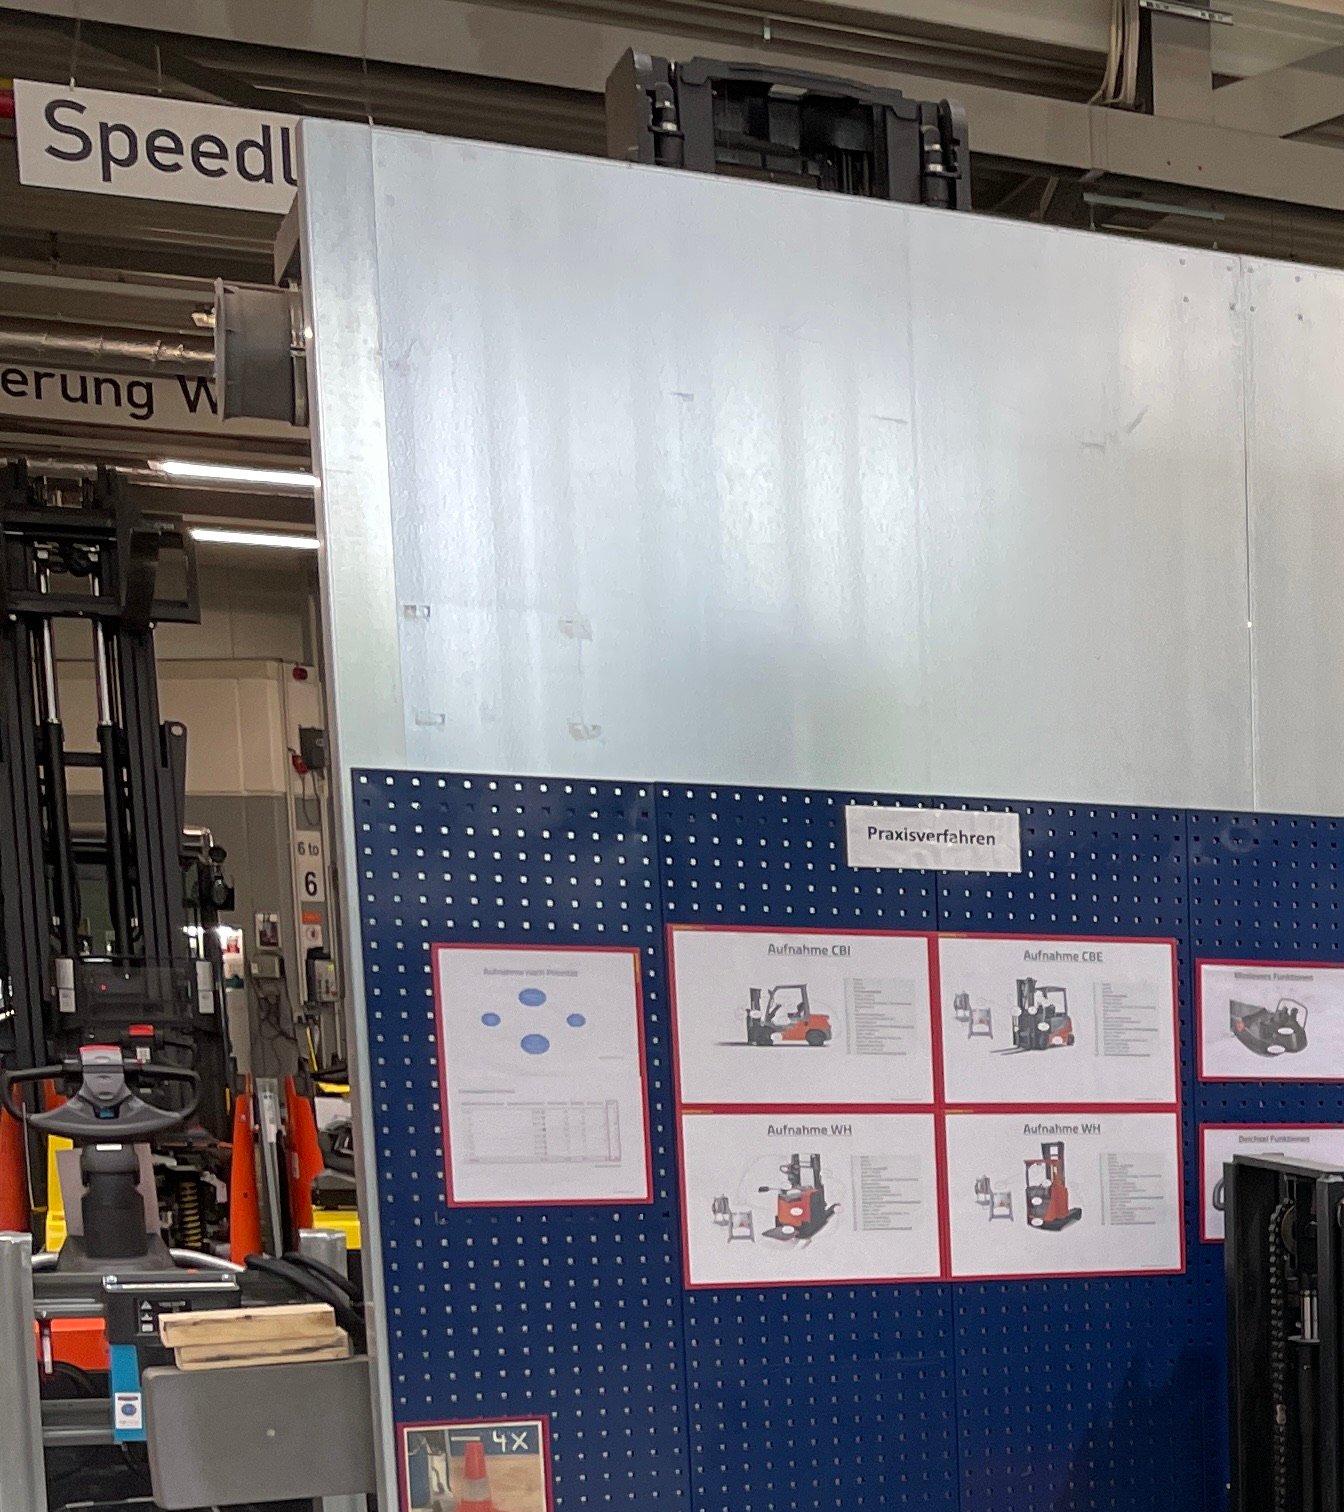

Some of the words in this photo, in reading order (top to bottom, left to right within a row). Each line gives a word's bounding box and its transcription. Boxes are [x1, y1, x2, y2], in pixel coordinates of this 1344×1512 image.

[867, 826, 996, 846] Praxisverfahren
[304, 871, 318, 896] 6
[767, 944, 829, 957] Aufnahme
[1023, 950, 1079, 962] Aufnahme
[1082, 951, 1104, 962] CBE
[767, 1124, 828, 1136] Aufnahme
[830, 1124, 852, 1135] WH
[1023, 1123, 1079, 1134] Aufnahme
[1081, 1124, 1101, 1134] WH
